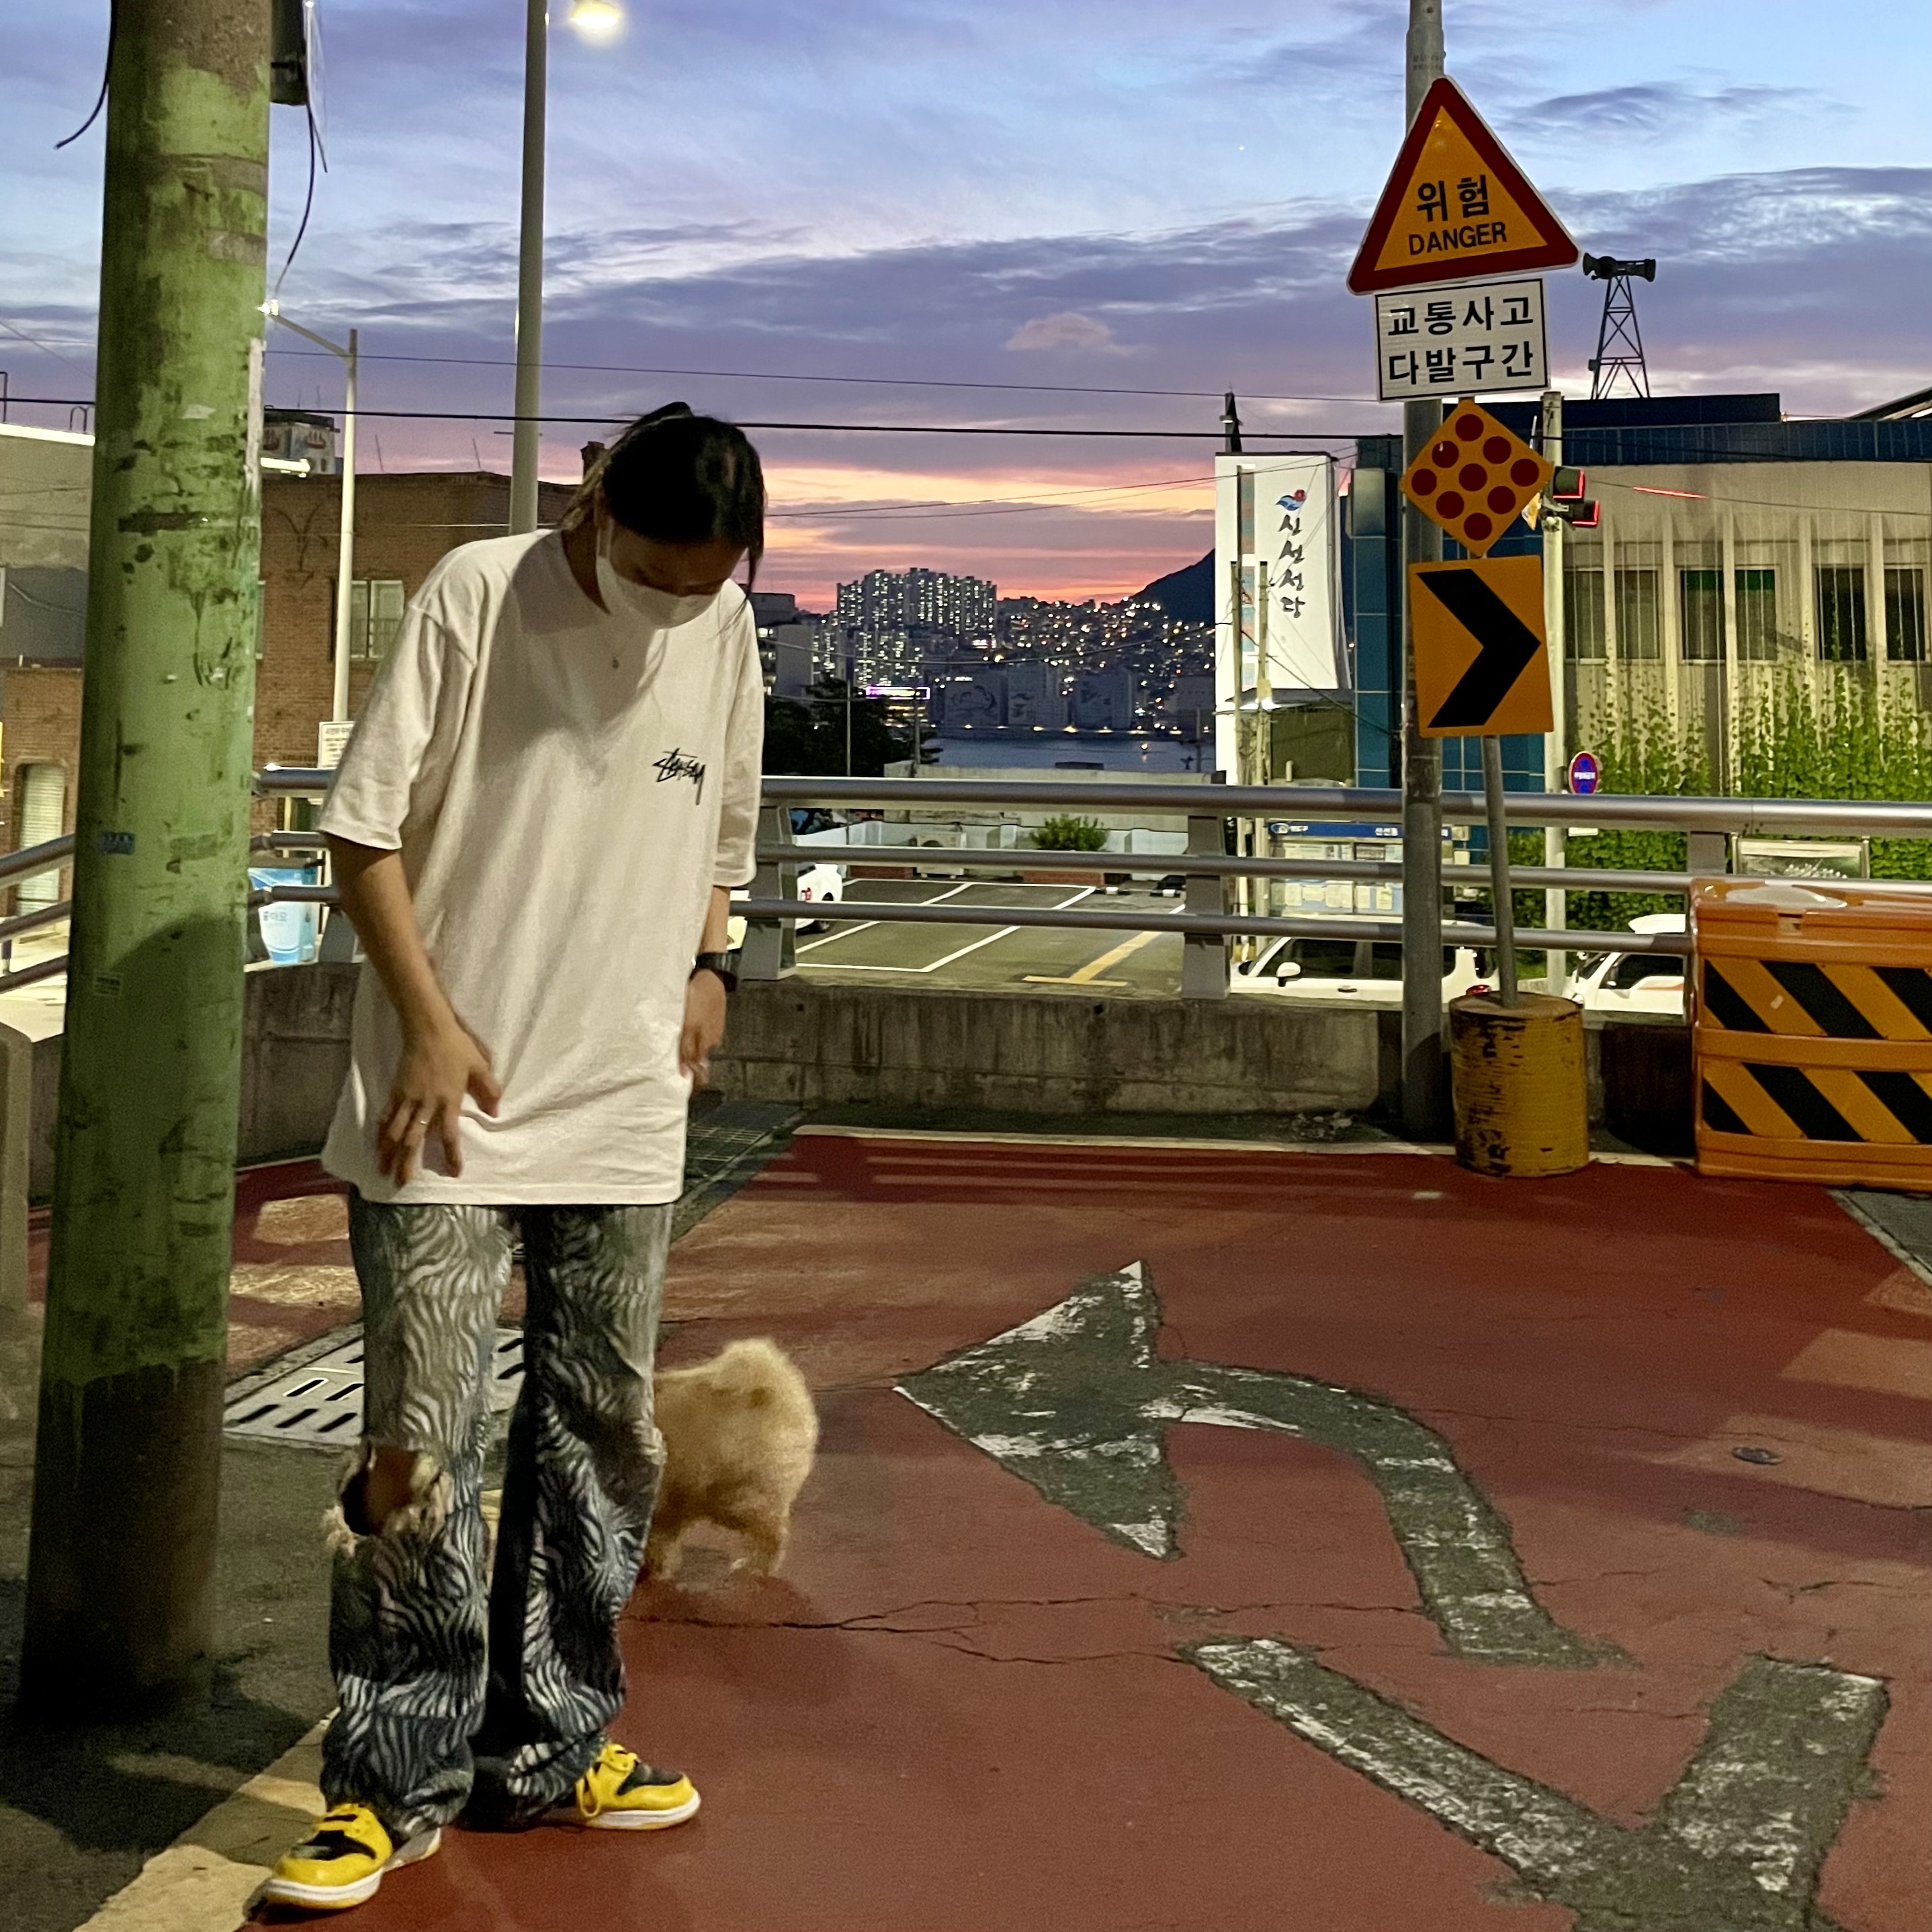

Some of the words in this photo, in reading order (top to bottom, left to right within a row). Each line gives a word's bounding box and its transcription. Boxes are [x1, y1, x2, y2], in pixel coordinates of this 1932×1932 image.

[1416, 174, 1489, 222] 위험
[1409, 222, 1507, 255] DANGER
[1387, 296, 1534, 336] 교통사고
[1388, 341, 1534, 386] 다발구간
